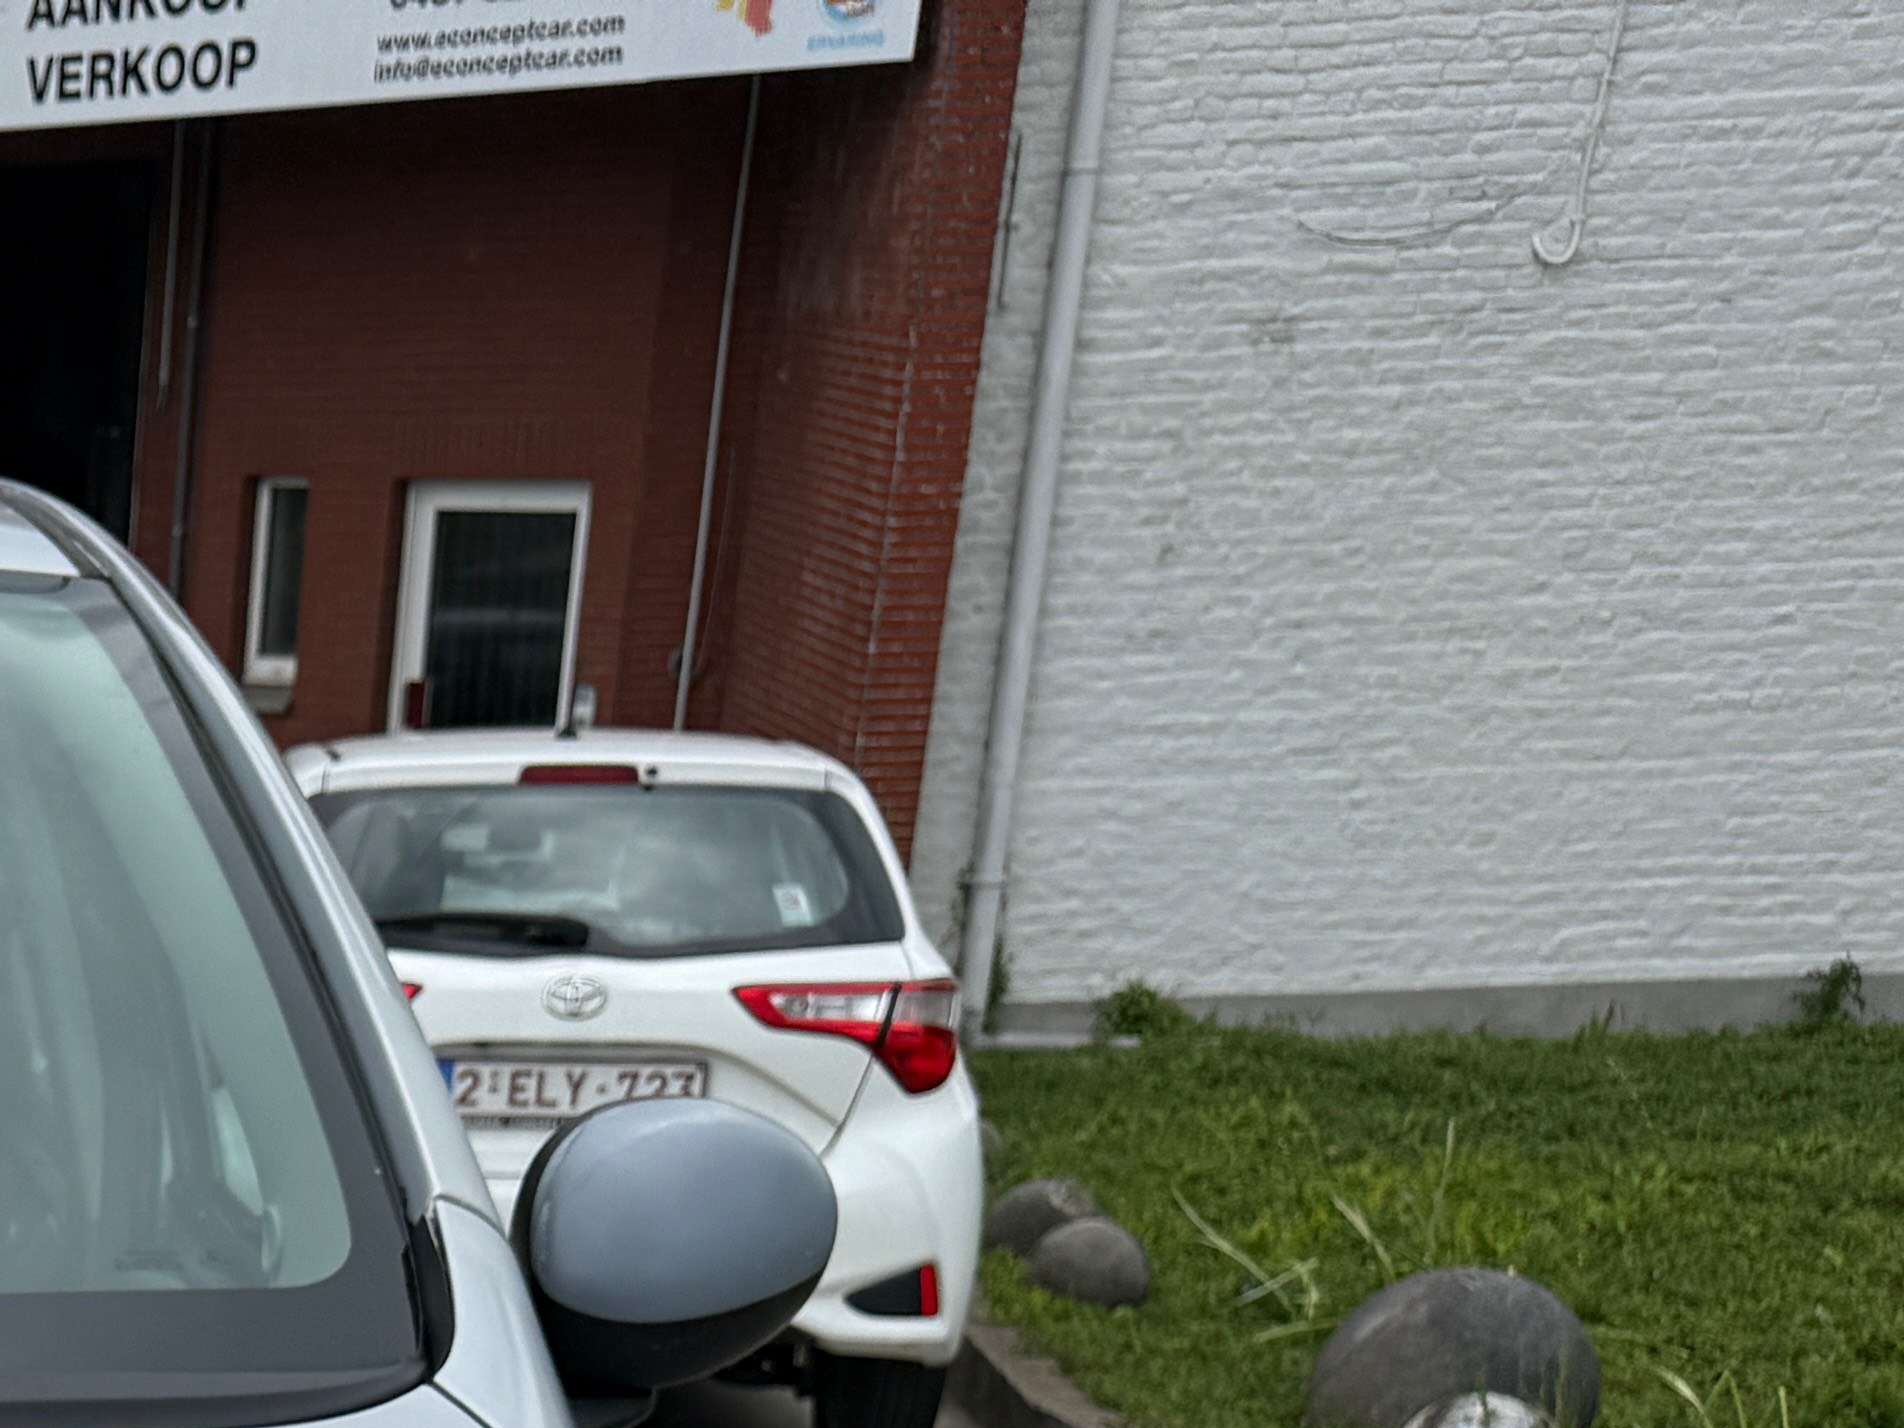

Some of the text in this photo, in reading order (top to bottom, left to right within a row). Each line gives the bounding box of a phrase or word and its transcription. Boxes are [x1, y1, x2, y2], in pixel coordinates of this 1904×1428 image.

[376, 15, 626, 53] www.econceptcar.com
[26, 37, 257, 104] VERKOOP
[373, 45, 624, 84] info@econceptcar.com
